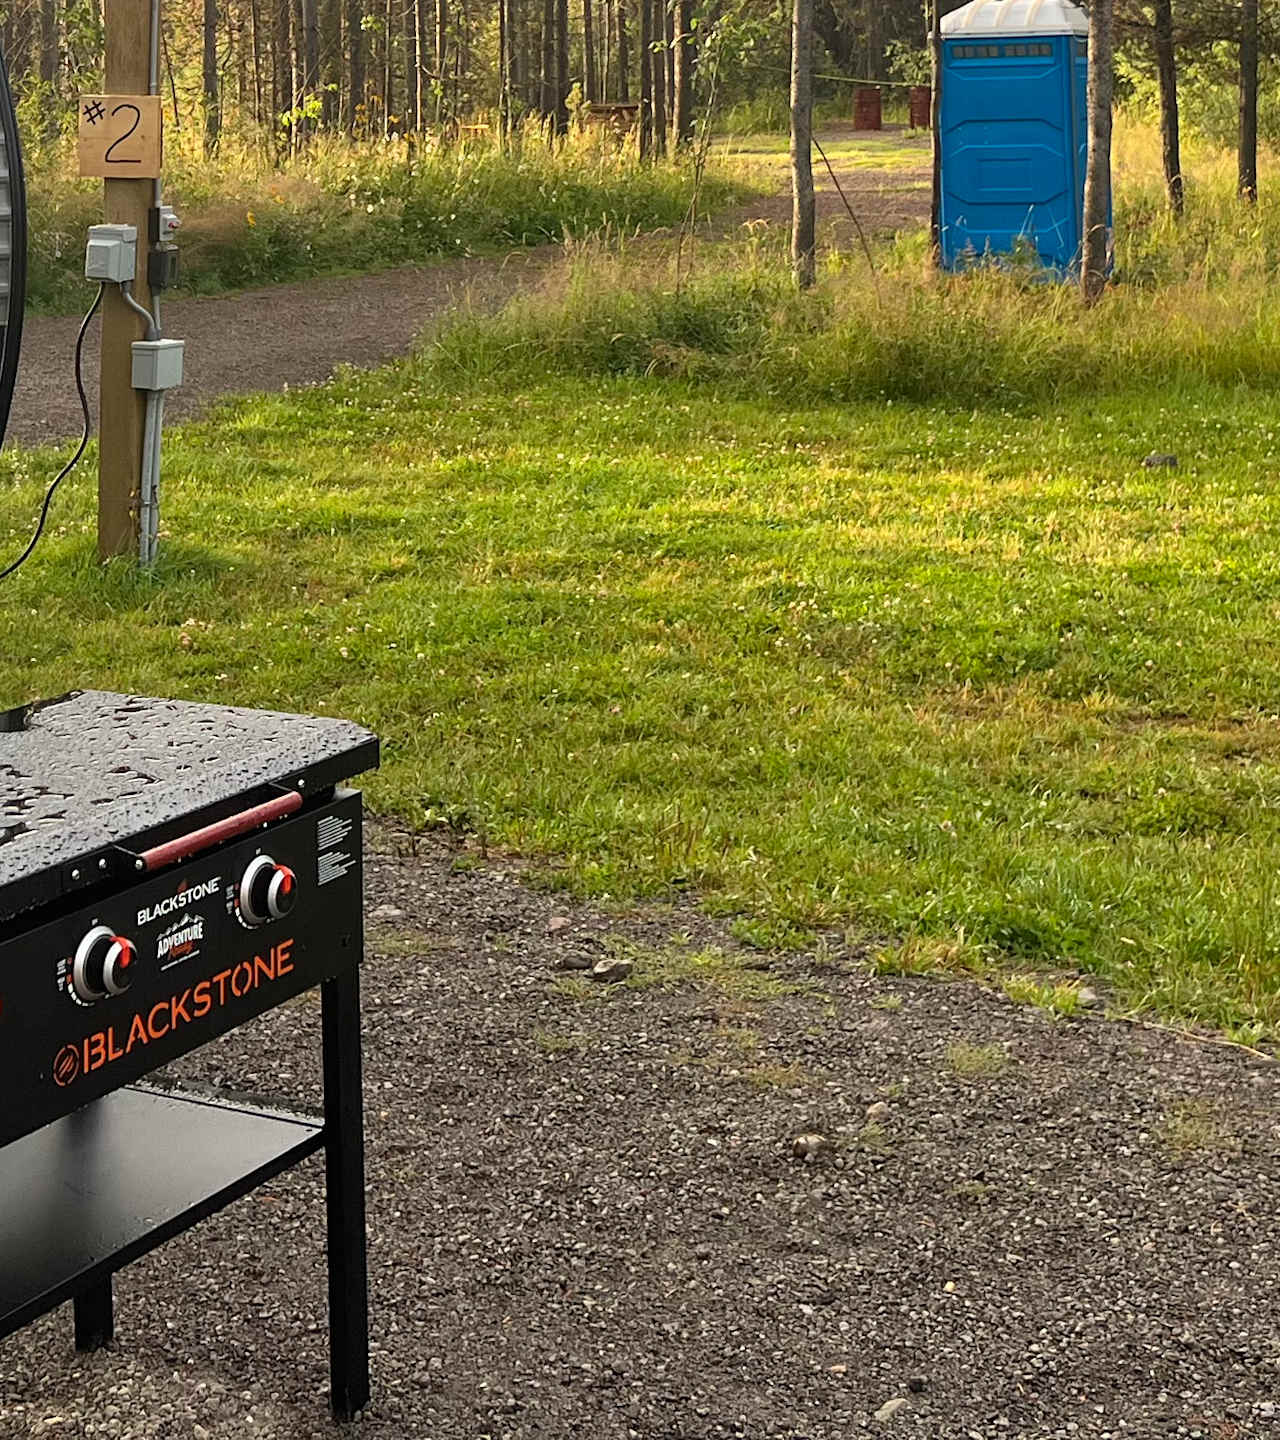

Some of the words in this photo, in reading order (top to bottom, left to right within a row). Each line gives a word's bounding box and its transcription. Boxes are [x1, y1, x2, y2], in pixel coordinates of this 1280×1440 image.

[82, 100, 142, 163] #2
[137, 876, 222, 926] BLACKSTONE
[157, 921, 203, 959] ADVENTURE
[83, 938, 295, 1074] BLACKSTONE
